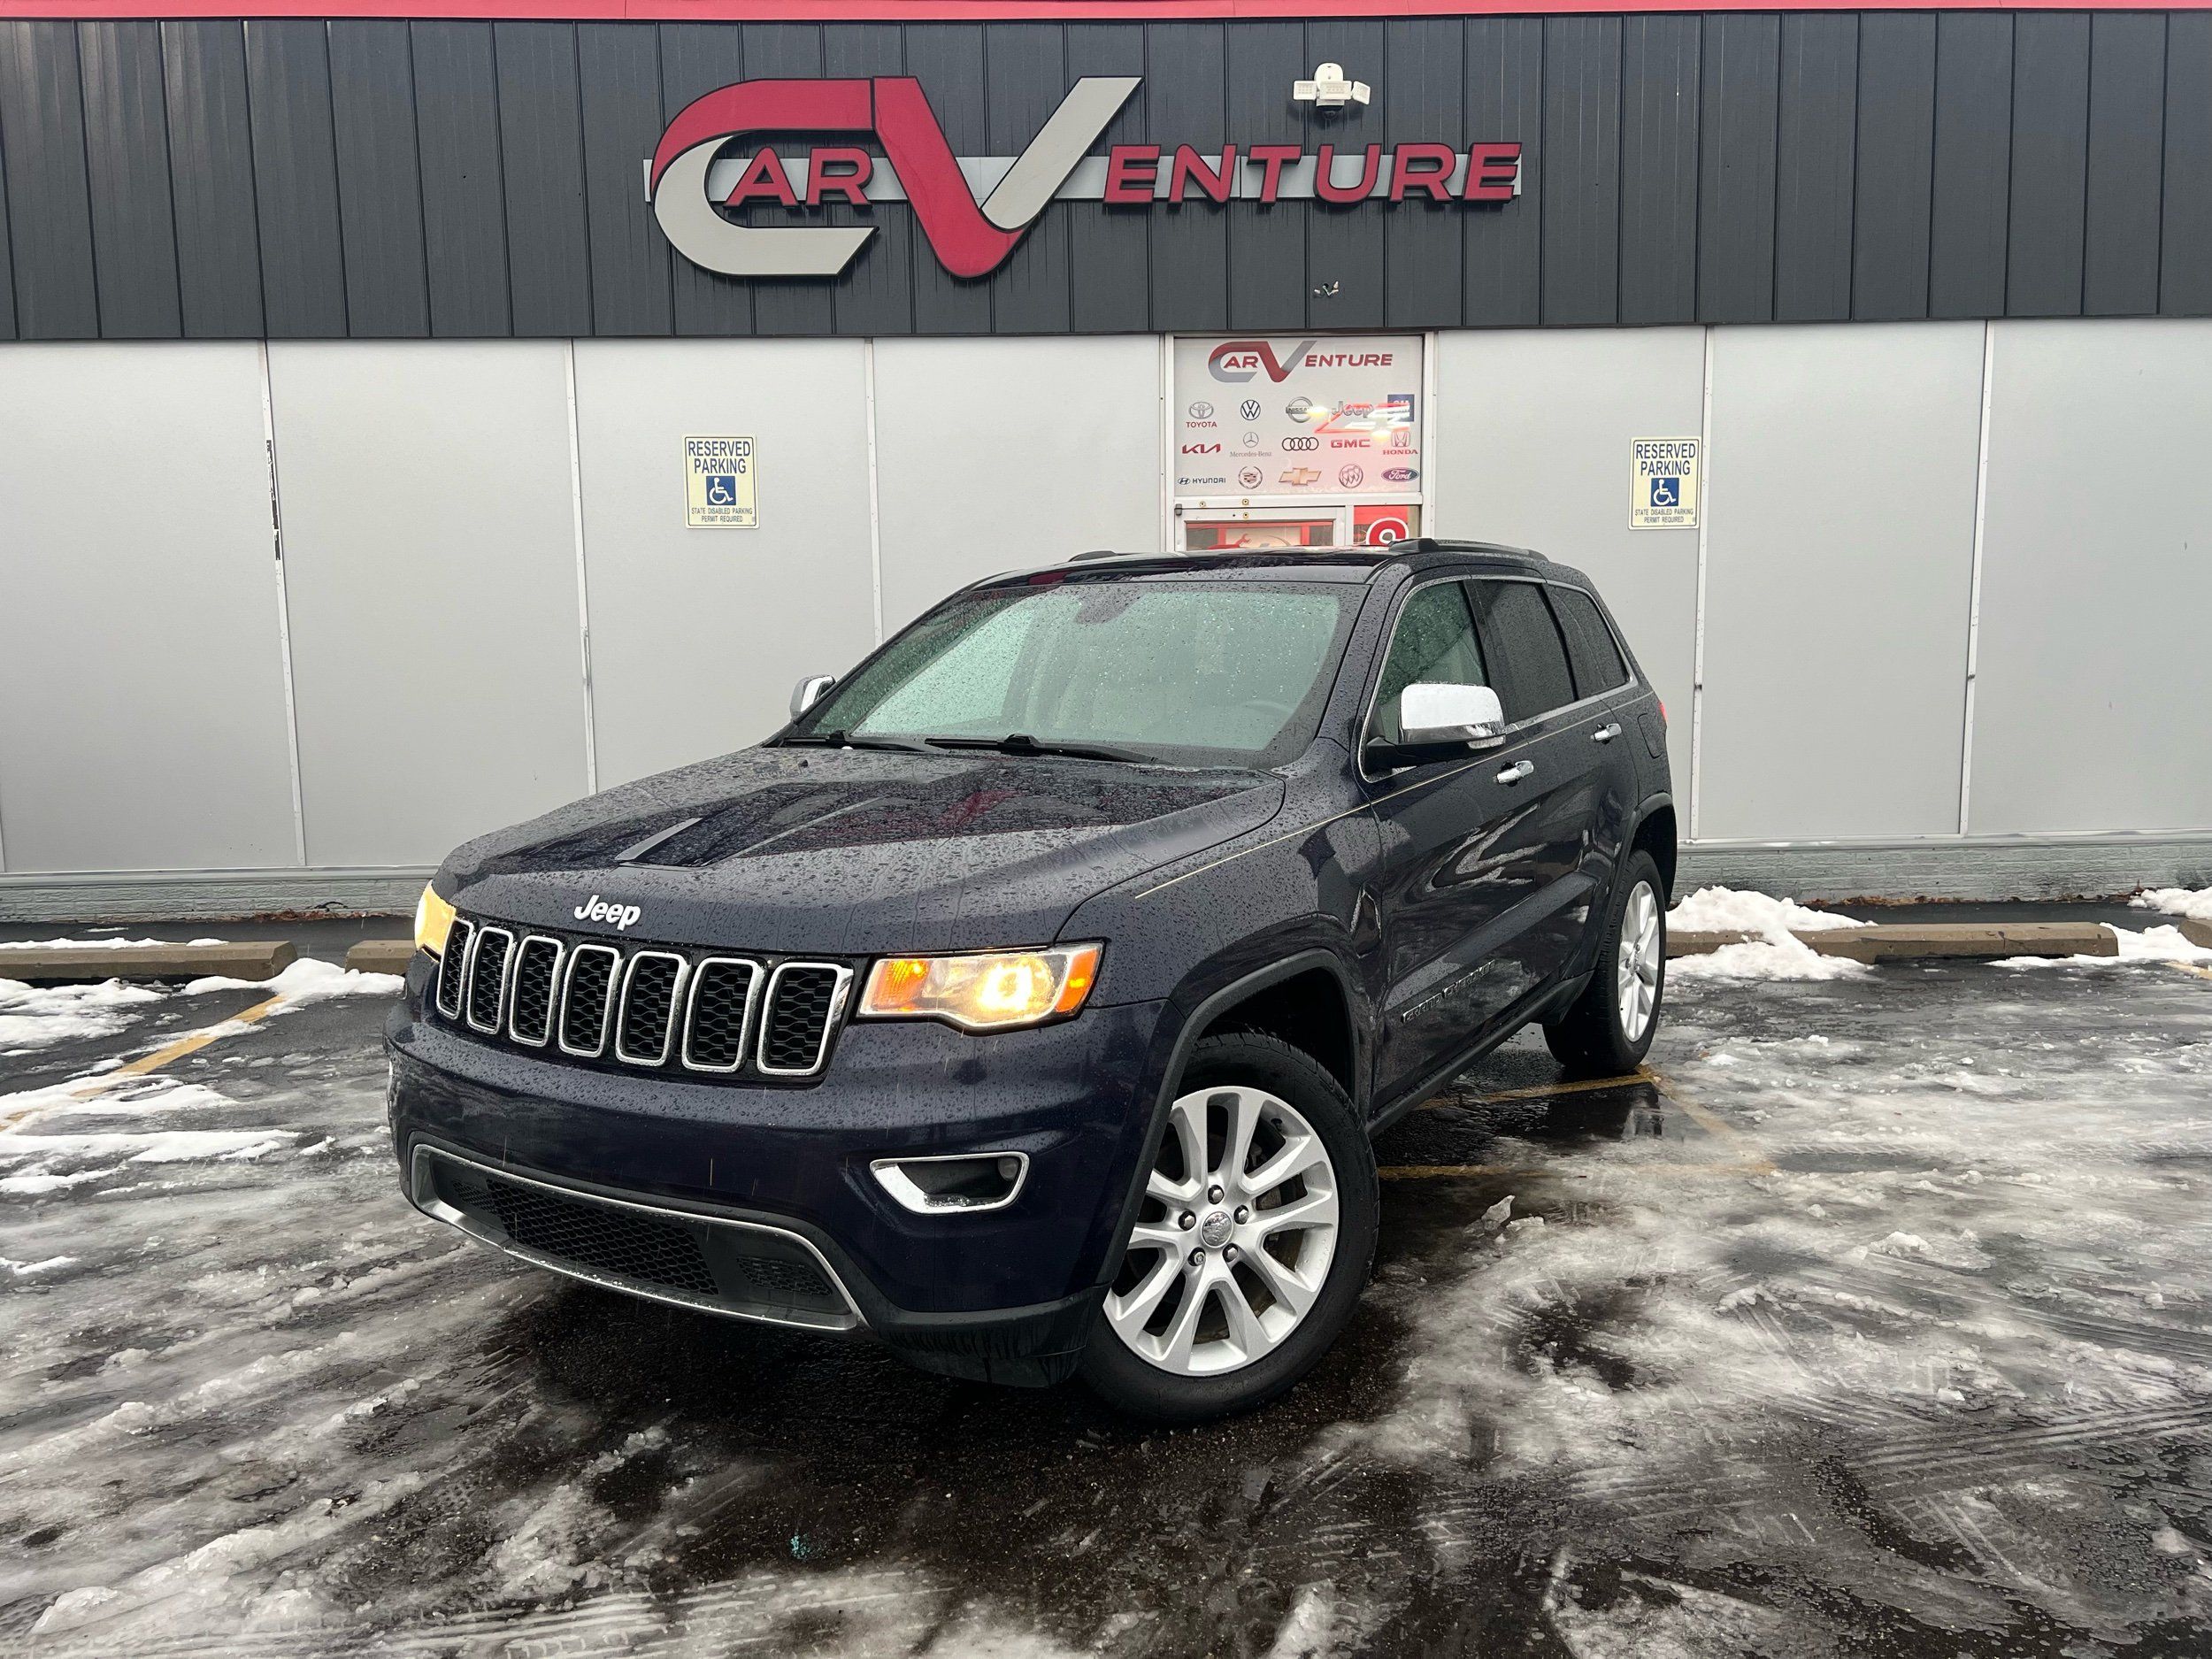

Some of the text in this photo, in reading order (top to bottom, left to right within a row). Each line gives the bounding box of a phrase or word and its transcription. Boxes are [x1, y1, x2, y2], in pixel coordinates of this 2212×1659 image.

[687, 441, 751, 457] RESERVED
[1330, 439, 1371, 449] GMC
[1635, 443, 1696, 459] RESERVED
[694, 458, 747, 474] PARKING
[1640, 460, 1691, 476] PARKING
[1388, 469, 1412, 480] Ford
[573, 895, 641, 932] Jeep
[1402, 992, 1443, 1024] GRAND
